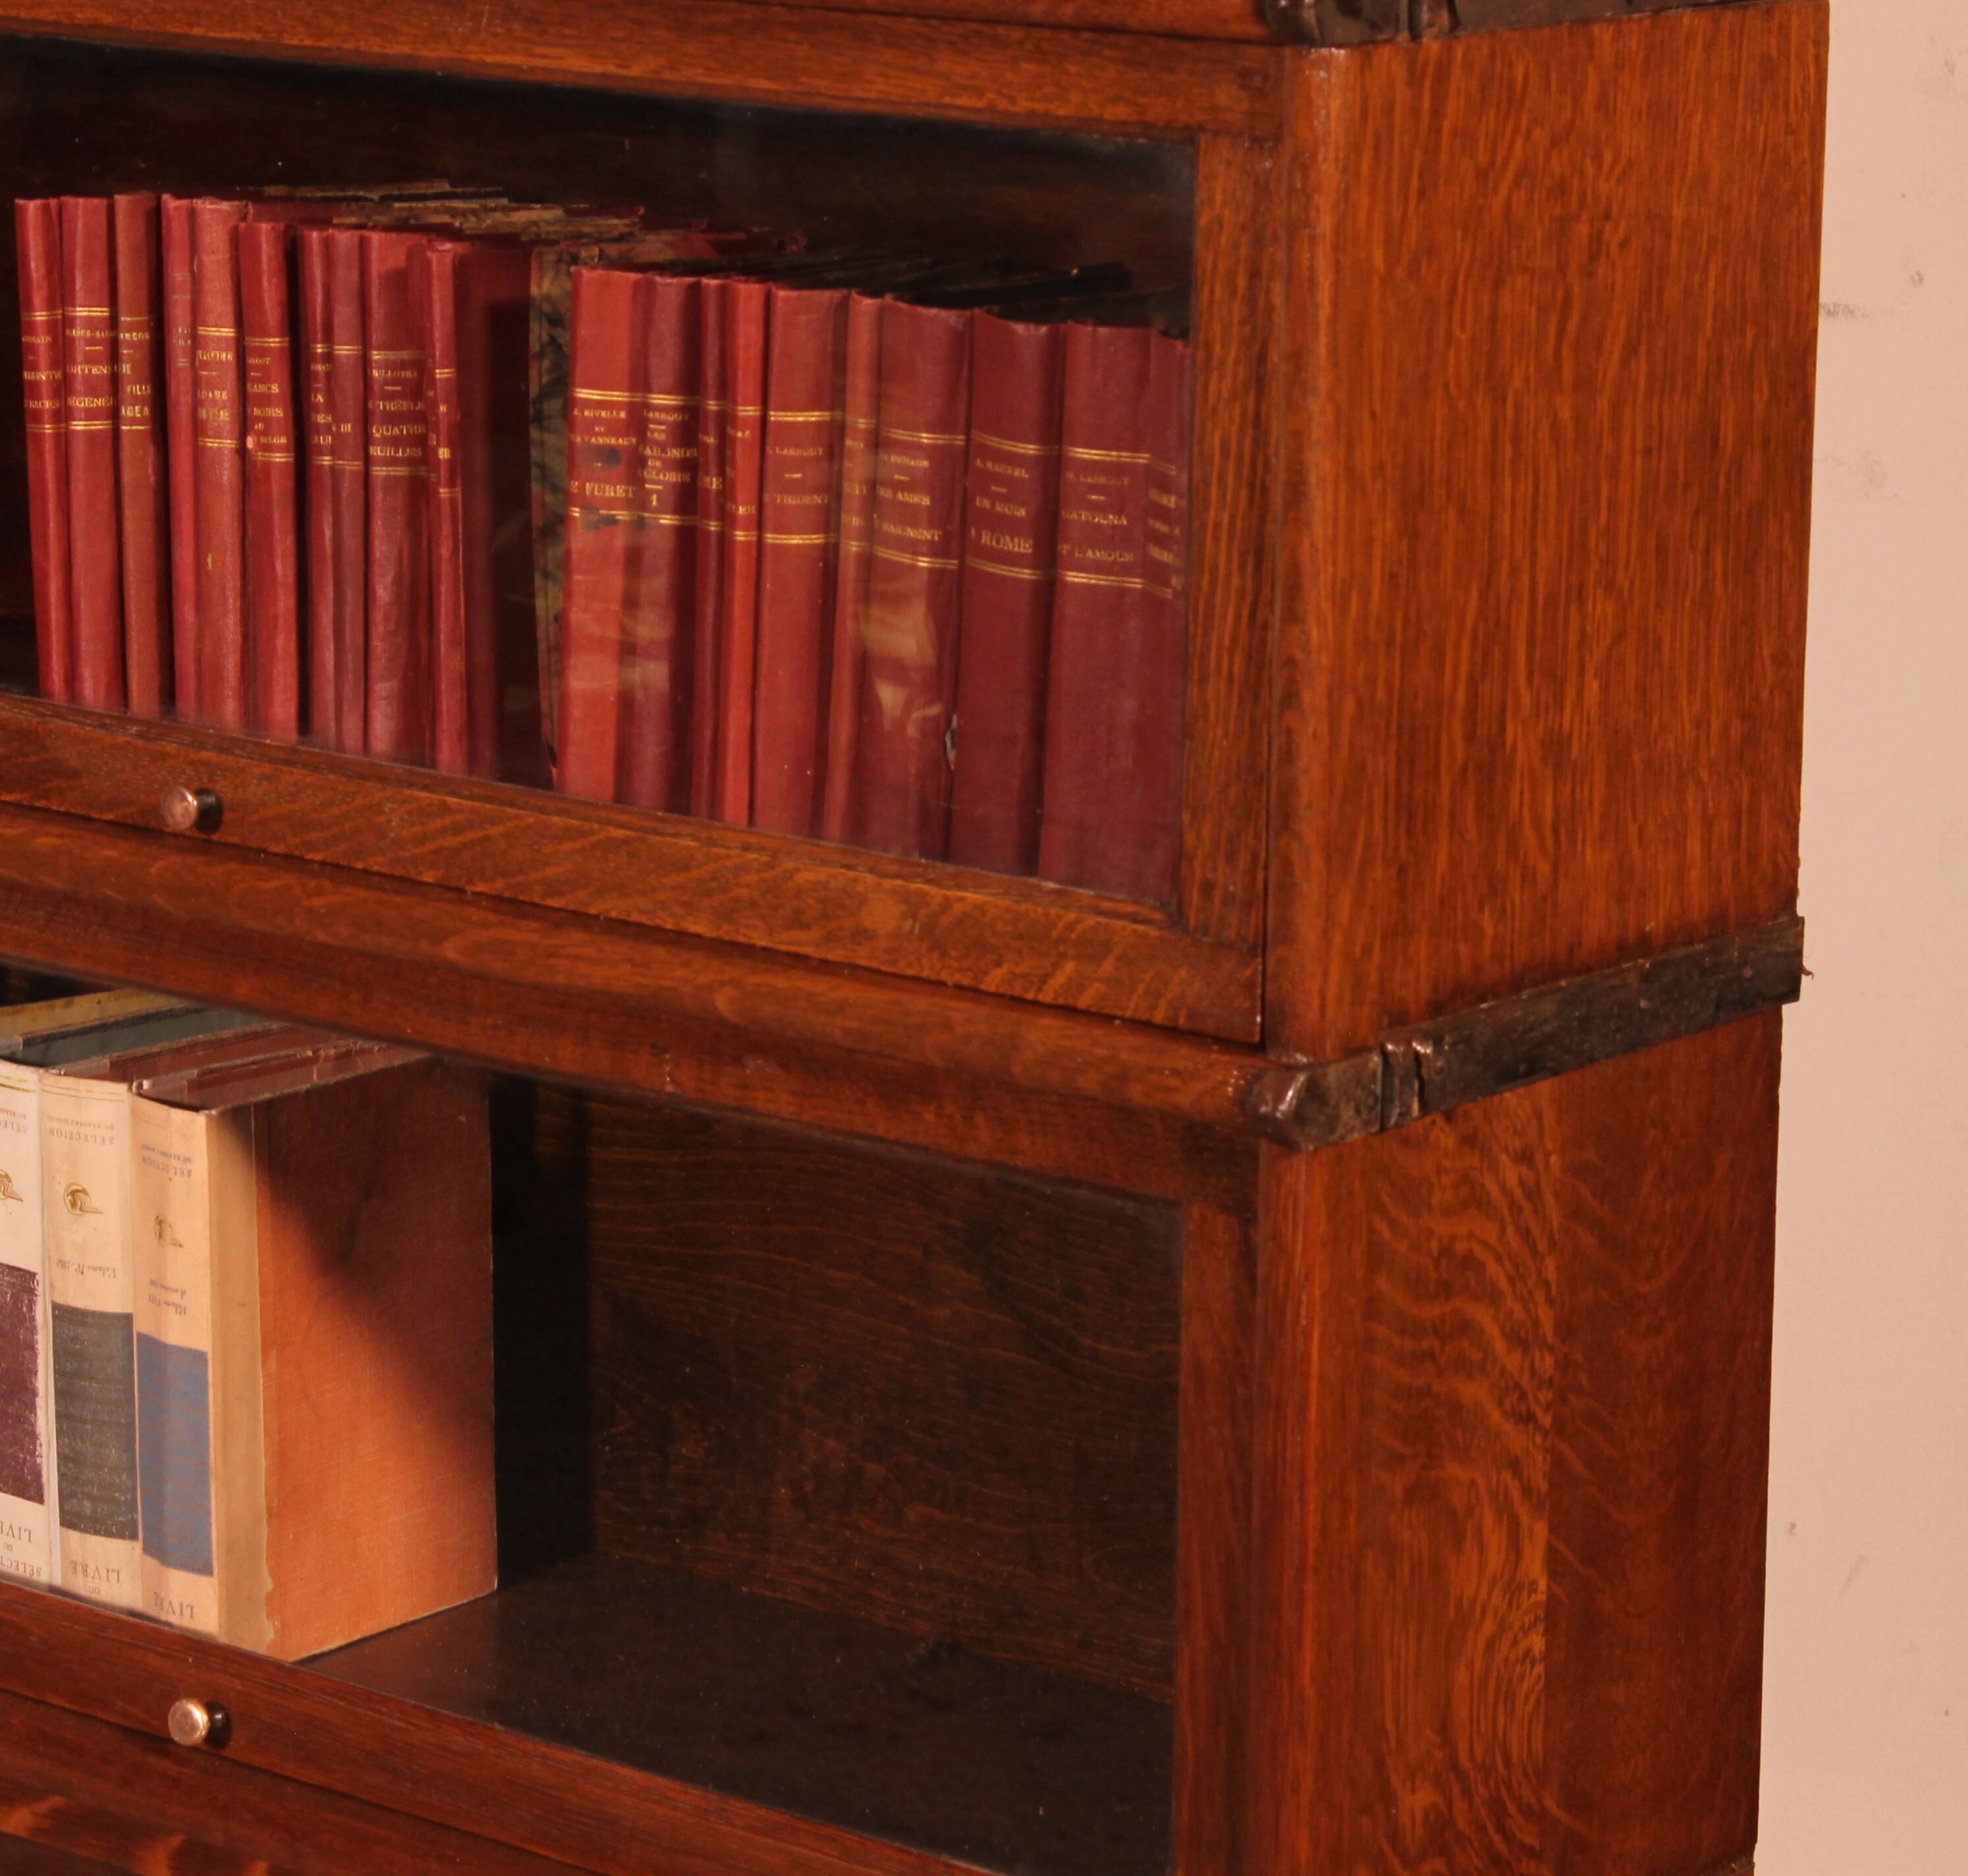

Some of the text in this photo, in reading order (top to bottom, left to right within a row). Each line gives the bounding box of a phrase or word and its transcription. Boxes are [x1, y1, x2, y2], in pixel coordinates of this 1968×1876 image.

[585, 481, 637, 499] FURET
[981, 529, 1033, 554] ROME
[70, 1560, 121, 1584] LIVRE
[153, 1591, 196, 1620] LIVRE
